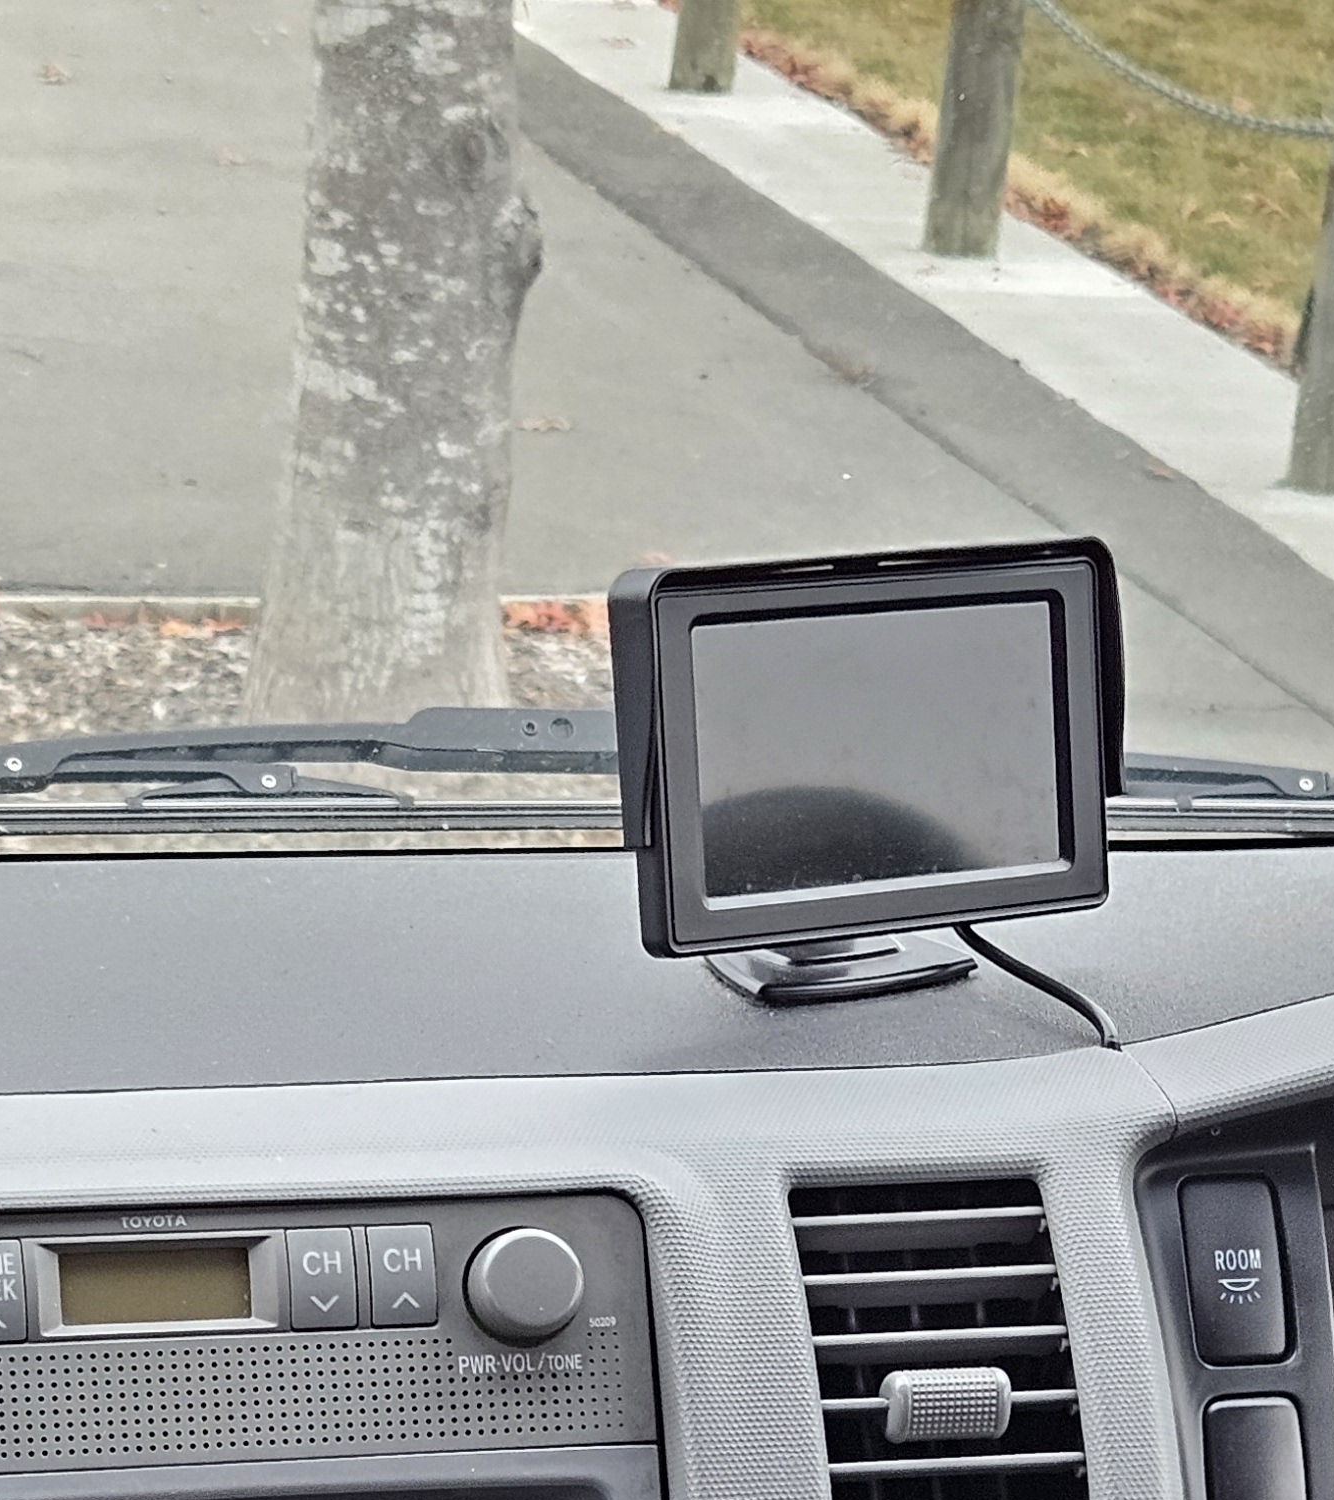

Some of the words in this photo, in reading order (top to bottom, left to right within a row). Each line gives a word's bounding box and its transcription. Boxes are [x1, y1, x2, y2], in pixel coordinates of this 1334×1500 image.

[120, 1214, 187, 1229] TOYOTA
[302, 1250, 342, 1276] CH
[382, 1248, 423, 1274] CH
[1214, 1249, 1262, 1271] ROOM
